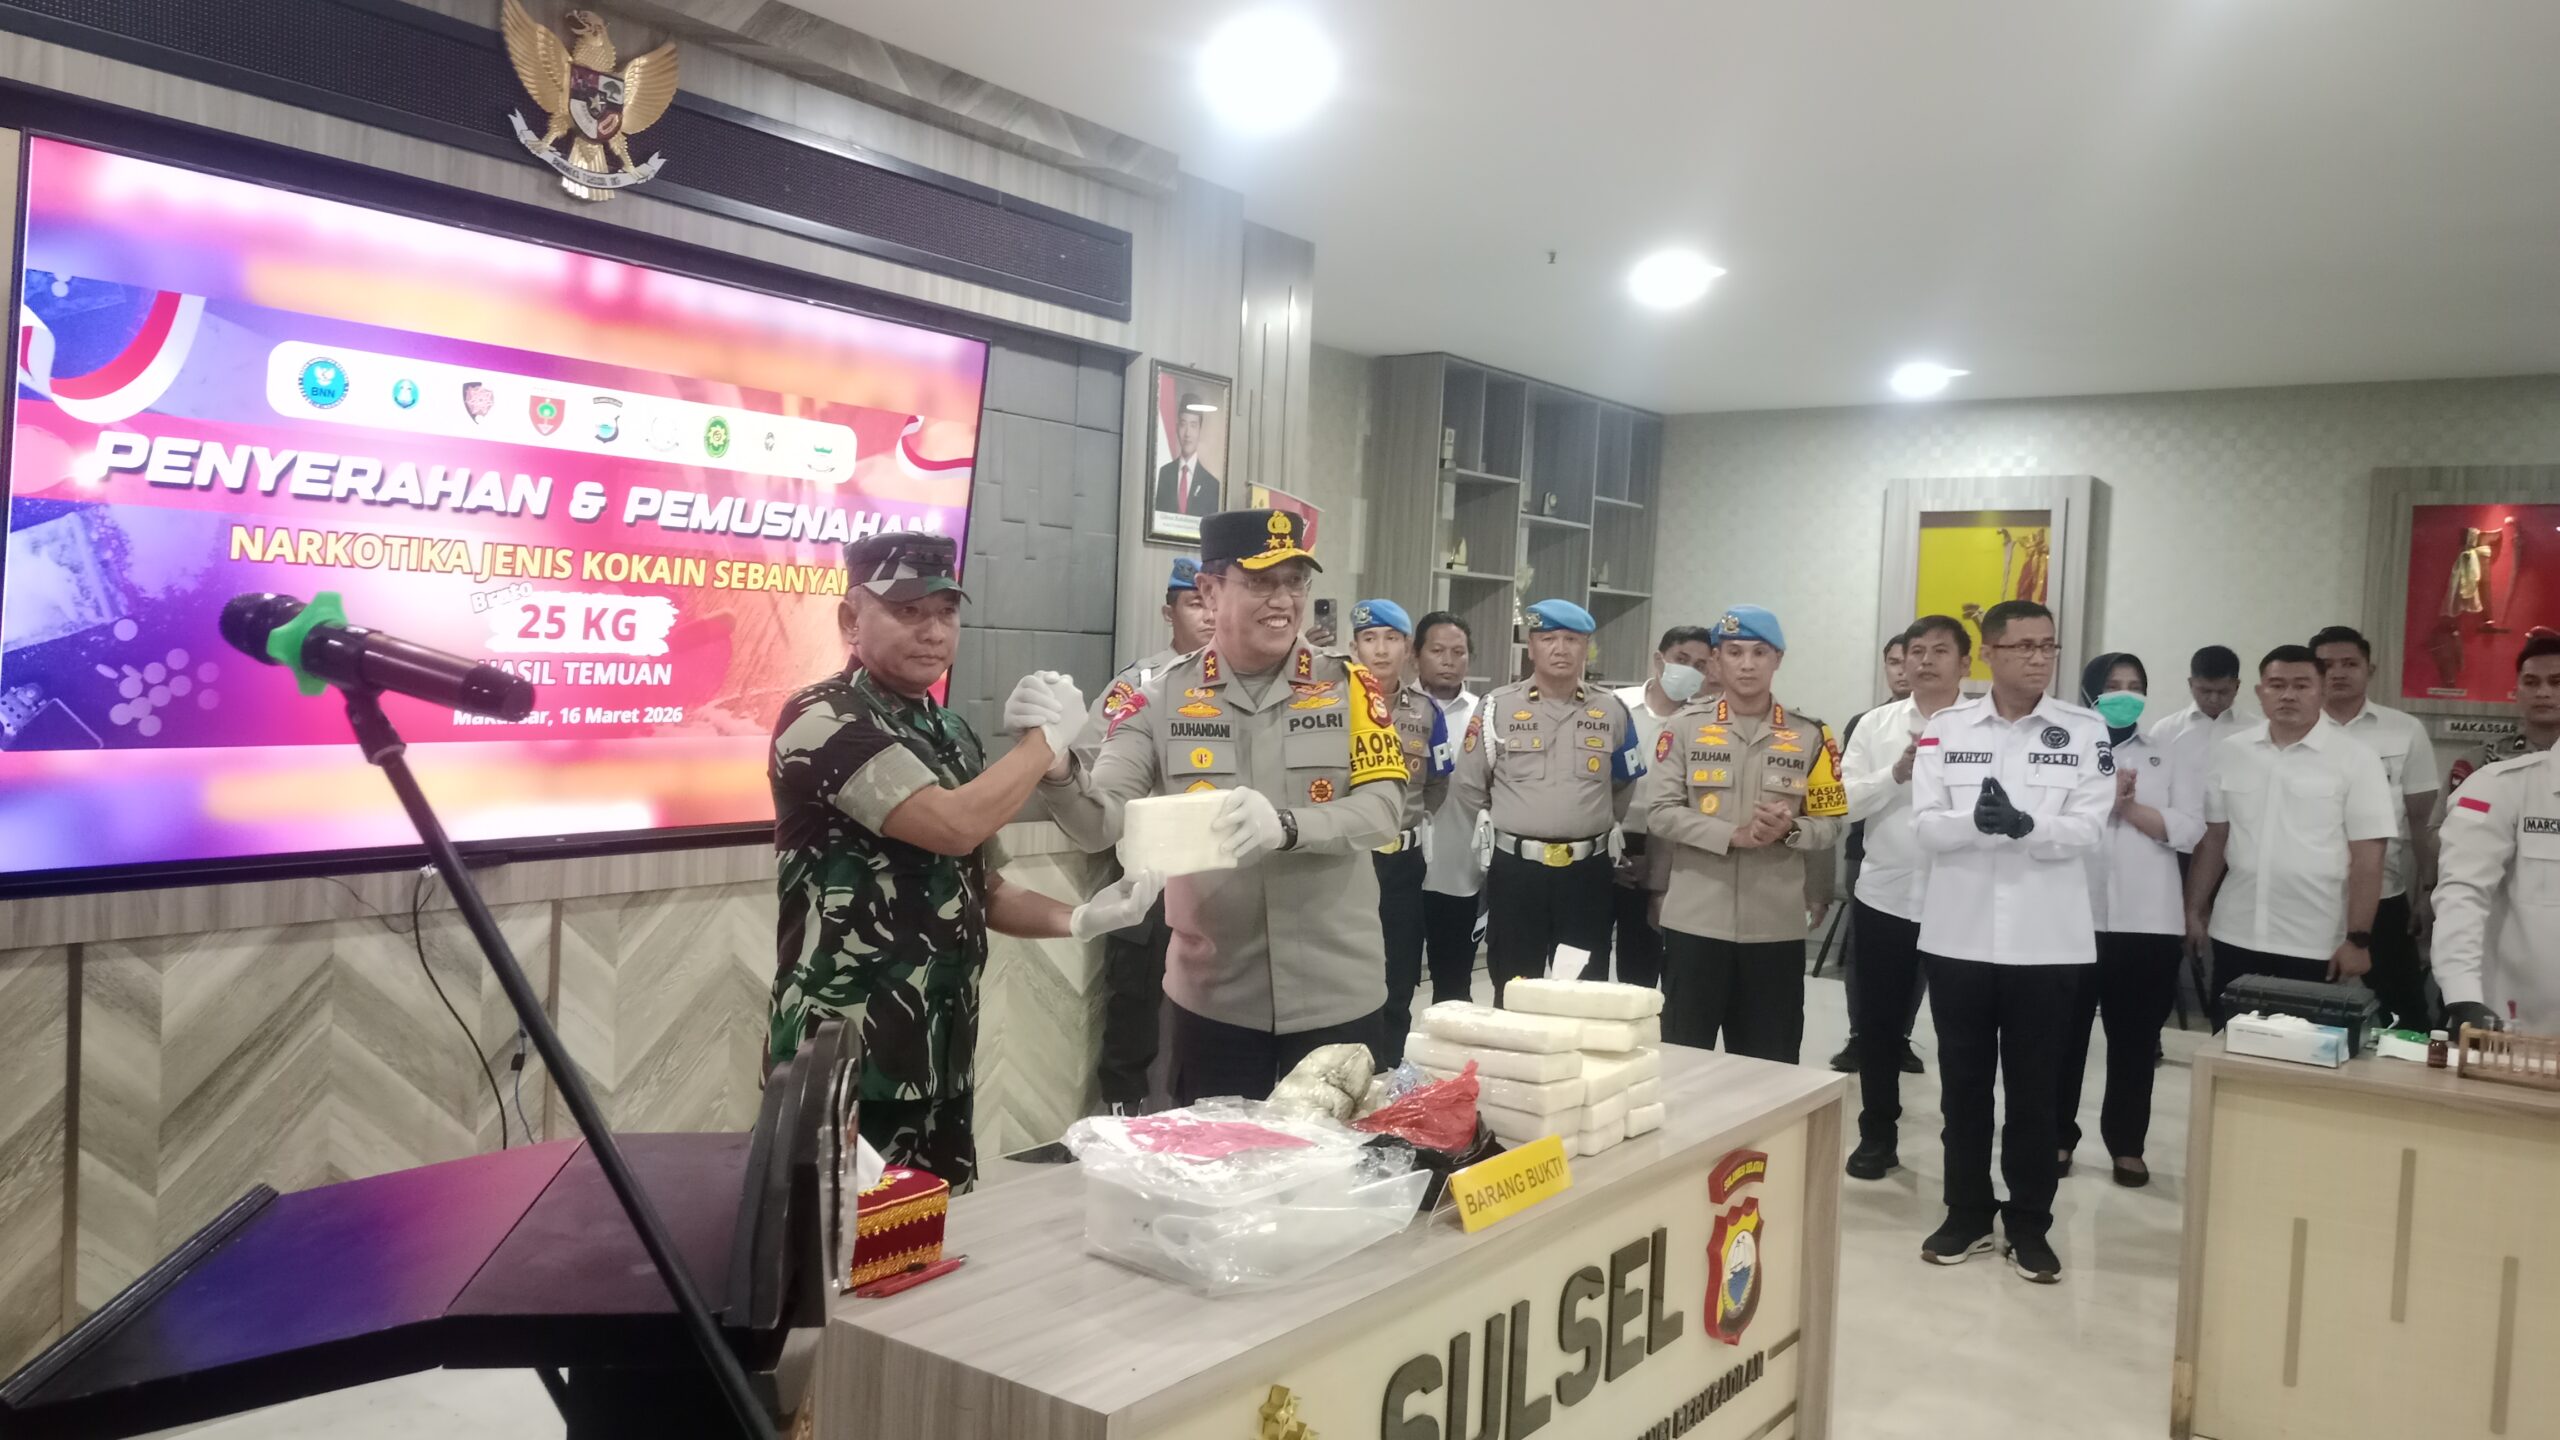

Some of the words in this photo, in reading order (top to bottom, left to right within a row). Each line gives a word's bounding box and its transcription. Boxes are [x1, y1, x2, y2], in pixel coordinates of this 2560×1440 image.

[311, 386, 336, 399] BNN
[95, 430, 553, 518] PENYERAHAN
[568, 481, 607, 523] &
[229, 524, 473, 575] NARKOTIKA
[474, 542, 574, 583] JENIS
[581, 551, 706, 588] KOKAIN
[517, 604, 566, 639] 25
[582, 607, 637, 641] KG
[478, 660, 557, 686] ASIL
[563, 662, 672, 685] TEMUAN
[560, 707, 581, 724] 16
[585, 707, 640, 724] Maret
[643, 706, 683, 723] 2026
[1289, 713, 1343, 732] POLRI
[1171, 723, 1231, 738] DJUHANDANI
[1509, 722, 1539, 732] DALLE
[1577, 721, 1610, 732] POLRI
[2450, 722, 2518, 734] MAKASSAR
[1350, 733, 1403, 759] AOPS
[1690, 752, 1731, 763] ZULHAM
[1767, 756, 1805, 771] POLRI
[1948, 752, 1988, 764] WAHYU
[2032, 753, 2074, 765] POLRI
[1465, 1174, 1525, 1215] BARANG
[1528, 1155, 1566, 1189] BUKTI
[1381, 1226, 1684, 1440] SULSEL
[1672, 1351, 1764, 1439] BERKEADILAN
